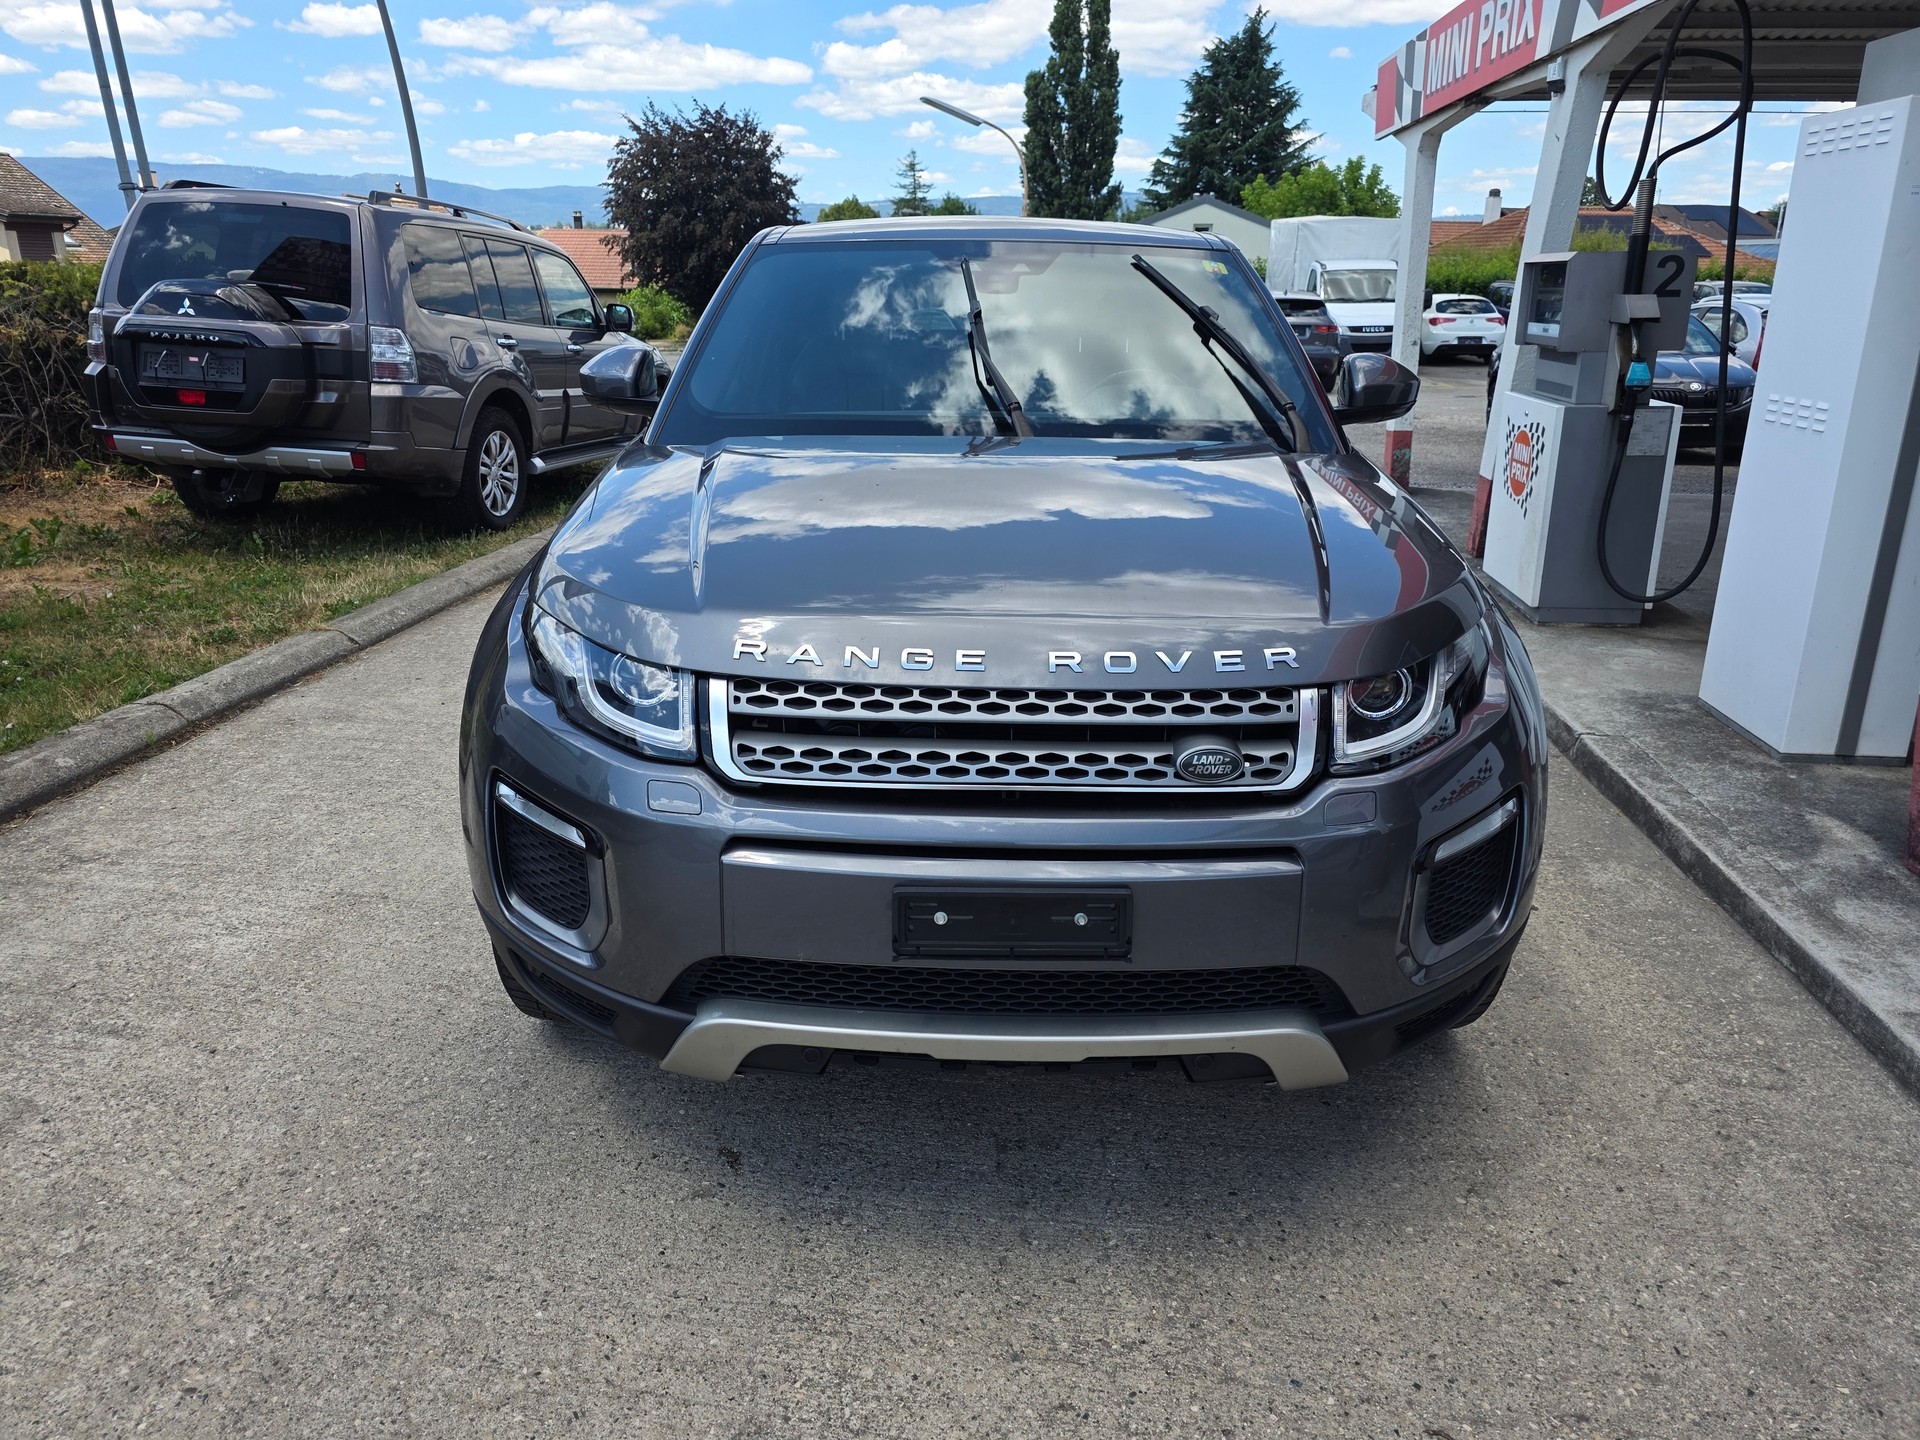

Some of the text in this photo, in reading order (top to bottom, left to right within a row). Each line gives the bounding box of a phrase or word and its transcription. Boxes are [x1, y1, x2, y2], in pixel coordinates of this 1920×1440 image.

[1427, 0, 1535, 95] MINI PRIX
[1653, 254, 1685, 297] 2
[150, 331, 219, 341] PAJERO
[1513, 441, 1531, 465] MINI
[1510, 461, 1529, 484] PRIX
[733, 638, 1300, 674] RANGE ROVER
[1192, 755, 1224, 765] LAND
[1194, 765, 1232, 774] ROVER
